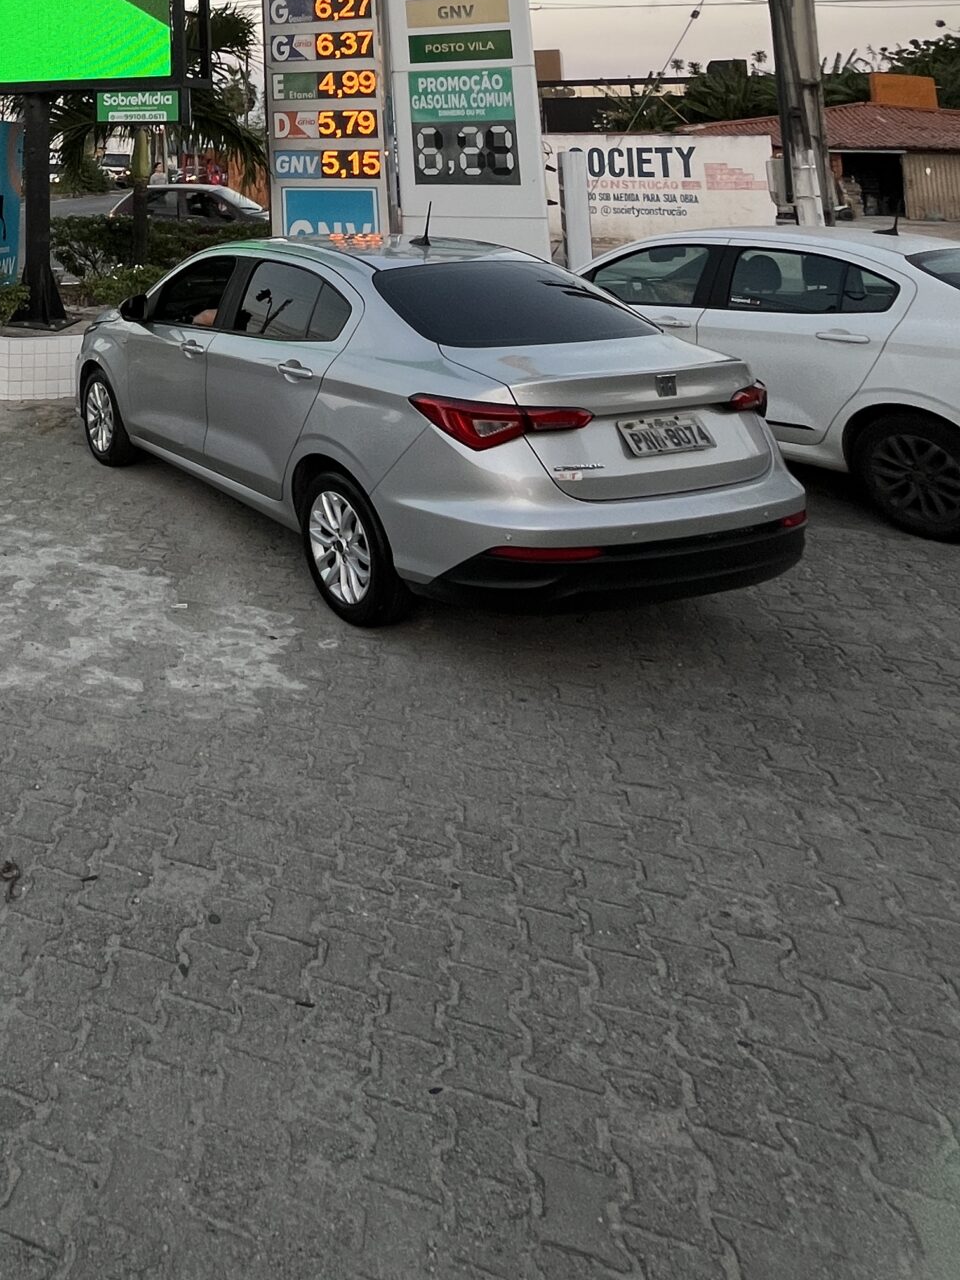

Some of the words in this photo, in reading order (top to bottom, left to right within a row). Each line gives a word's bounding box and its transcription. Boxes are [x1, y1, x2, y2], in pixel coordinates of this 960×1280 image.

[437, 4, 474, 19] GNV
[272, 35, 290, 61] G
[316, 31, 373, 59] 6,37
[425, 43, 465, 53] POSTO
[467, 41, 495, 51] VILA
[272, 74, 285, 99] E
[289, 89, 316, 99] Etanol
[319, 71, 376, 98] 4,99
[418, 71, 503, 94] PROMOÇÃO
[411, 93, 468, 109] GASOLINA
[470, 91, 513, 107] COMUM
[274, 112, 291, 138] D
[318, 110, 376, 138] 5,79
[275, 156, 319, 174] GNV
[321, 151, 381, 178] 5,15
[570, 145, 696, 178] OCIETY
[598, 192, 611, 202] SOB
[612, 193, 640, 202] MEDIDA
[642, 194, 660, 203] PARA
[663, 194, 678, 203] SUA
[680, 194, 699, 203] OBRA
